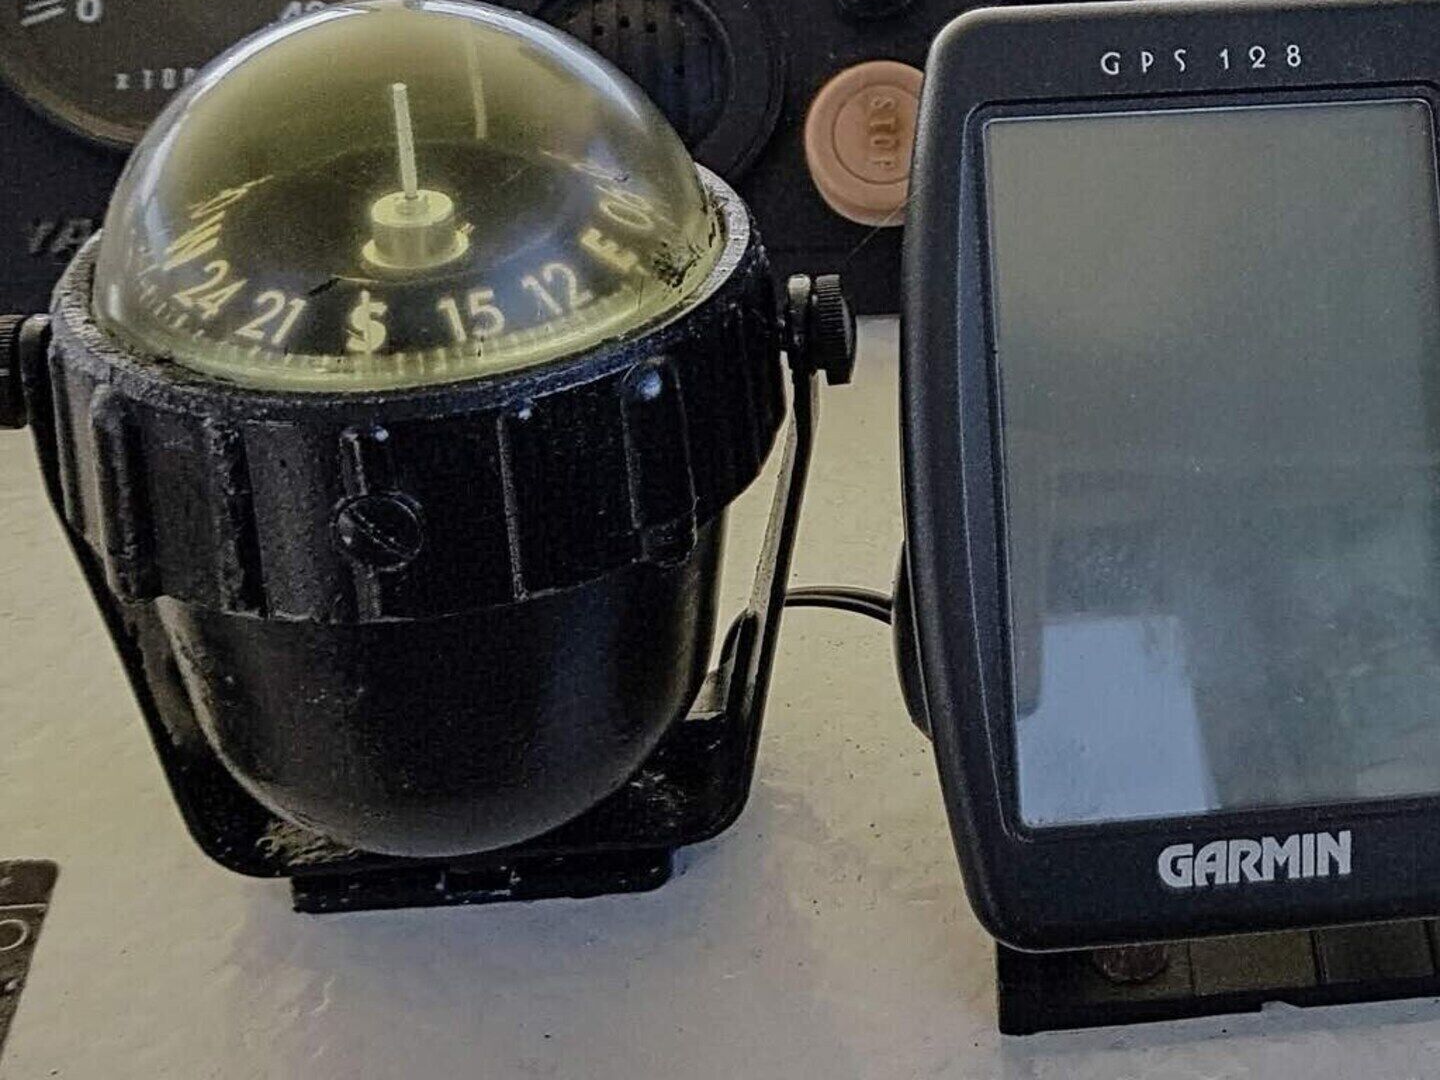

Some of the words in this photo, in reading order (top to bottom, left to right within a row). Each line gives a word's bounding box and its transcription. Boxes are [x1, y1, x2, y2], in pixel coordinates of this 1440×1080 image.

[1100, 48, 1187, 76] GPS
[1219, 43, 1302, 71] 128
[172, 259, 248, 320] 24
[234, 289, 308, 345] 21
[436, 288, 505, 342] 15
[520, 263, 595, 316] 12
[1158, 830, 1352, 889] GARMIN
